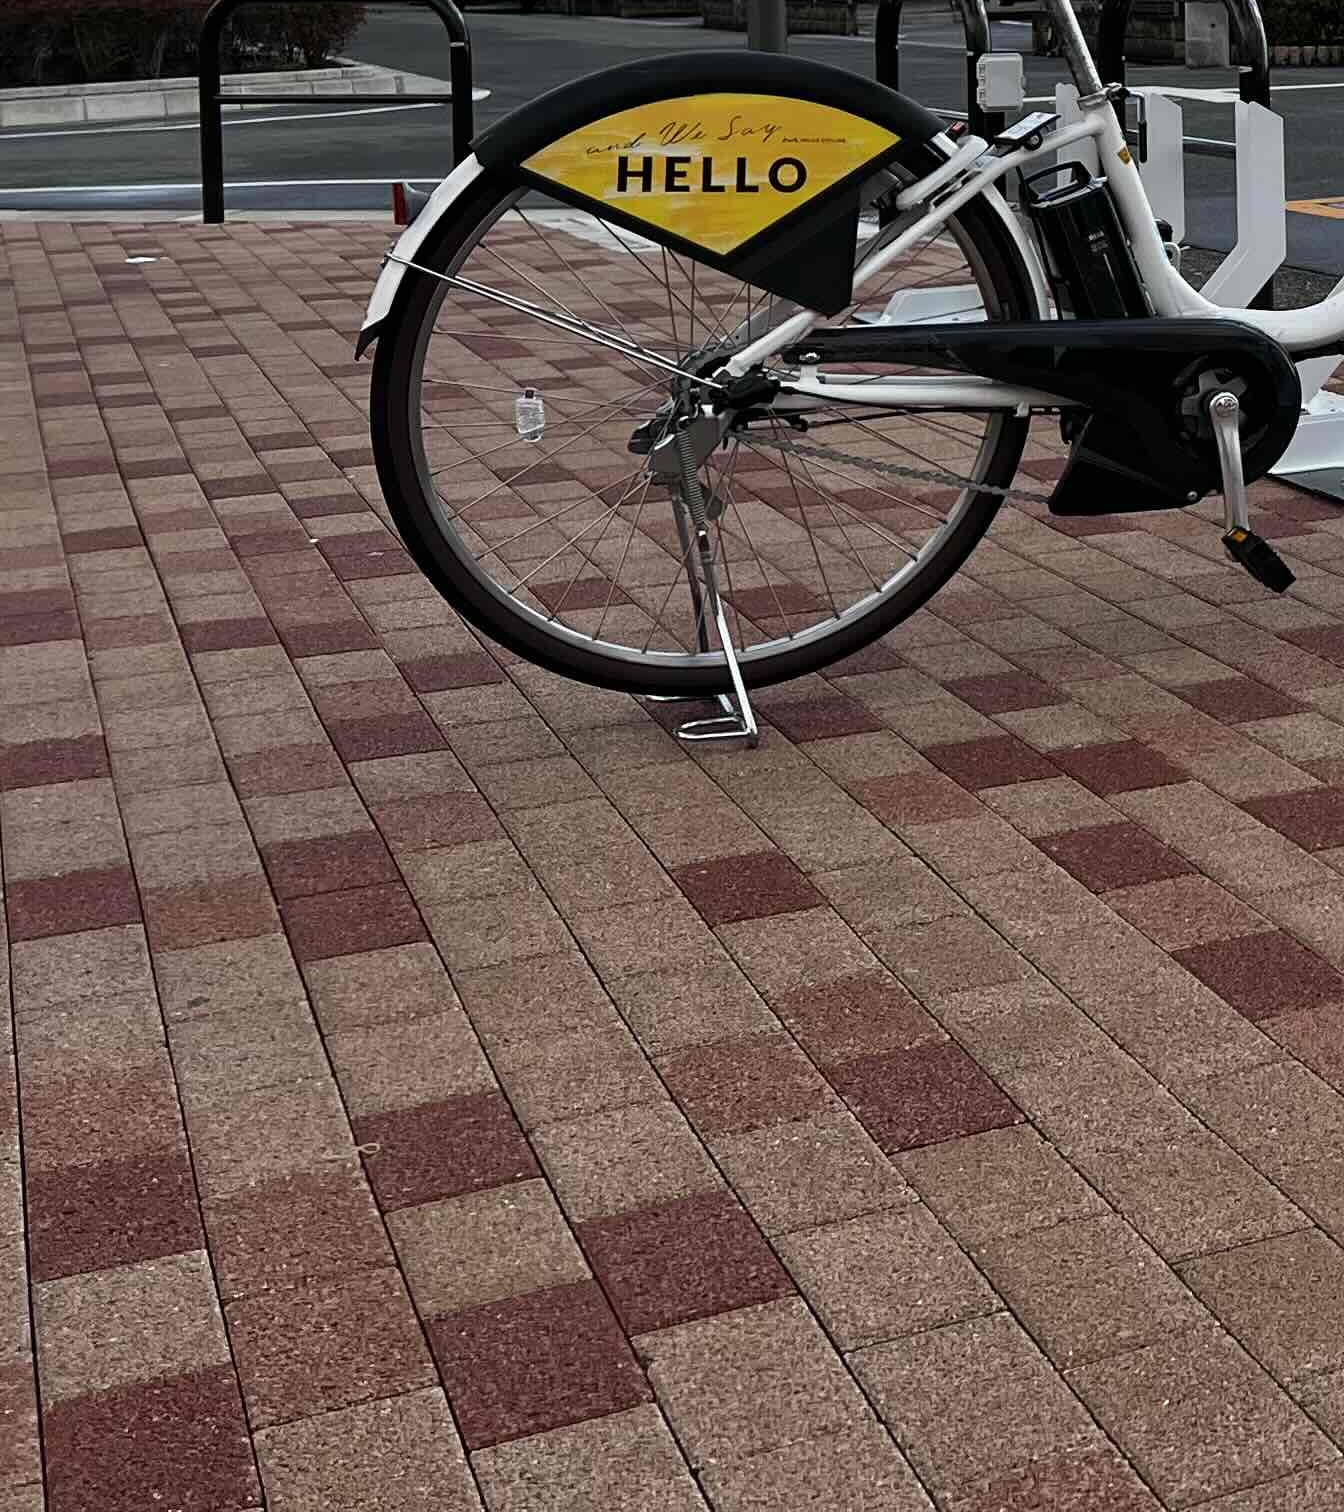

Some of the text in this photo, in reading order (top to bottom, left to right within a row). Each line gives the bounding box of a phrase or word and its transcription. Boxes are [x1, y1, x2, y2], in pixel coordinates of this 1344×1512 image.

[586, 114, 783, 156] and We Say
[616, 156, 808, 193] HELLO
